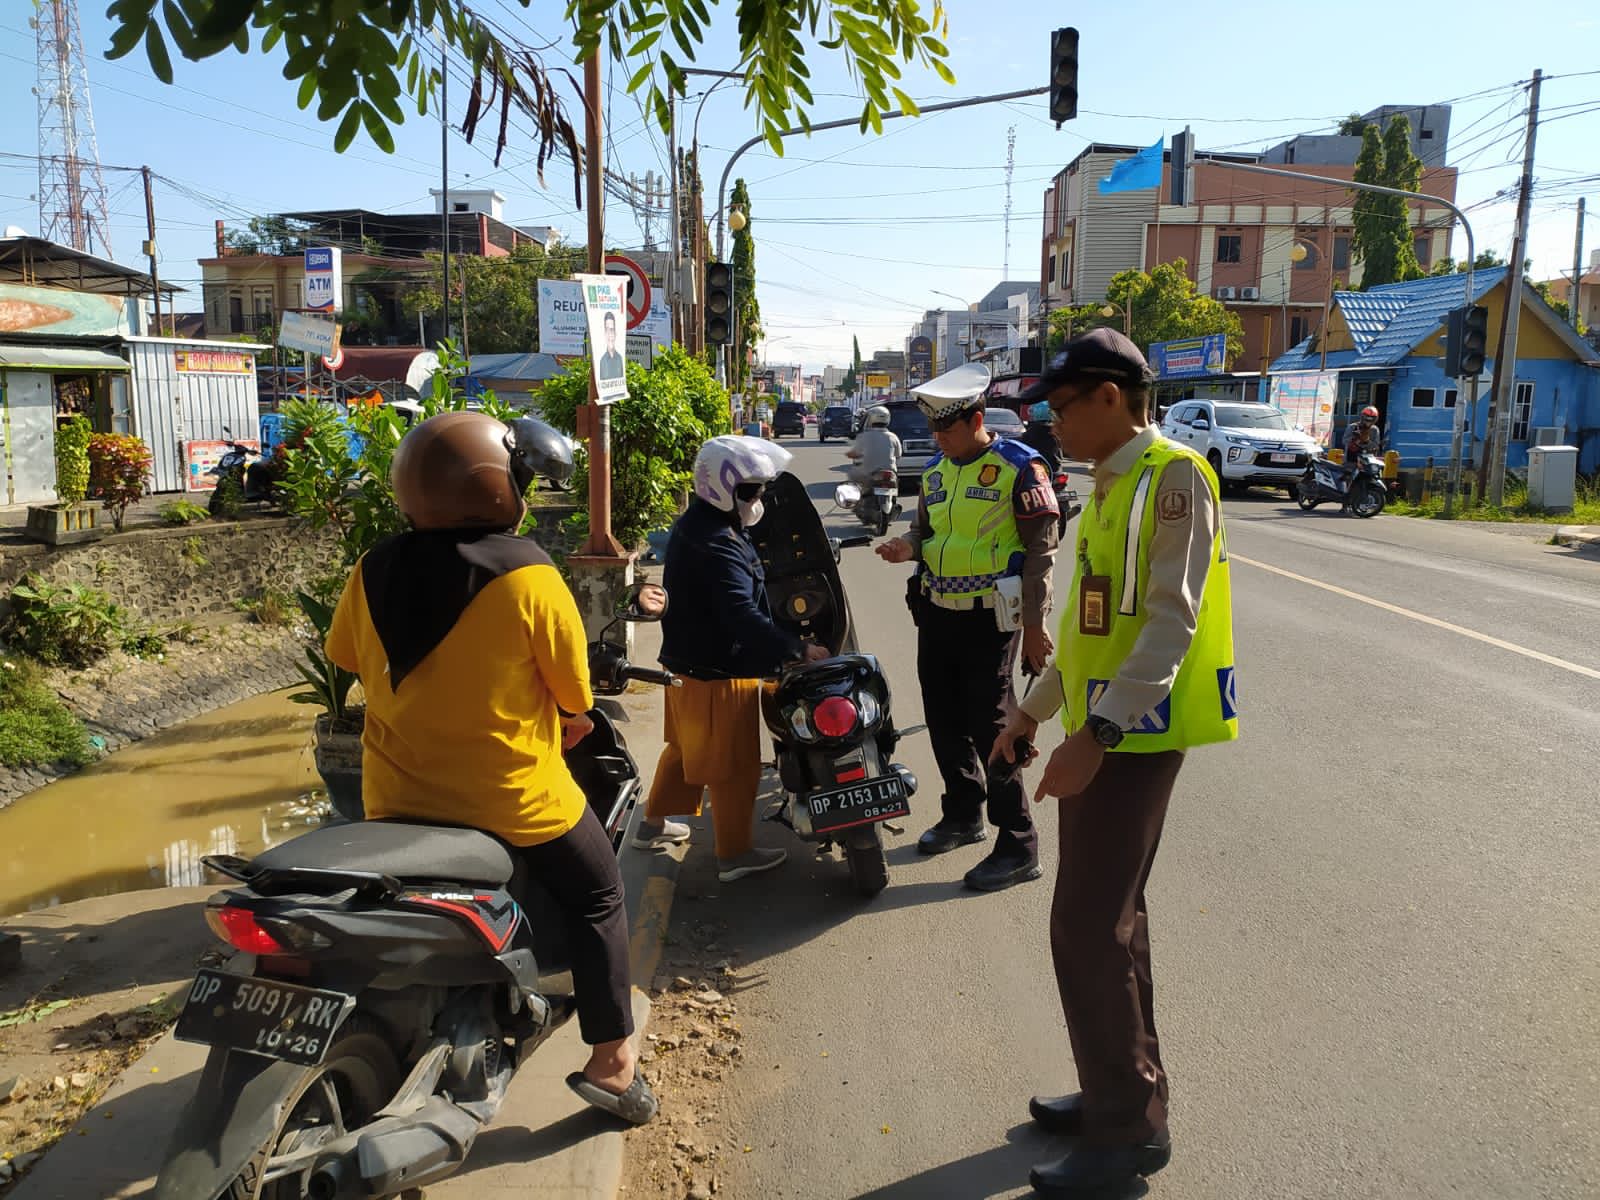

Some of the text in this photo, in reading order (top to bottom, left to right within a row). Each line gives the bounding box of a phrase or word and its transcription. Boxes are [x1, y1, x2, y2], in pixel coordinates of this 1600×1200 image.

[309, 278, 331, 291] ATM
[553, 300, 586, 312] REUN
[813, 781, 899, 814] DP 2153 LM
[190, 975, 339, 1029] DP 5091 RK
